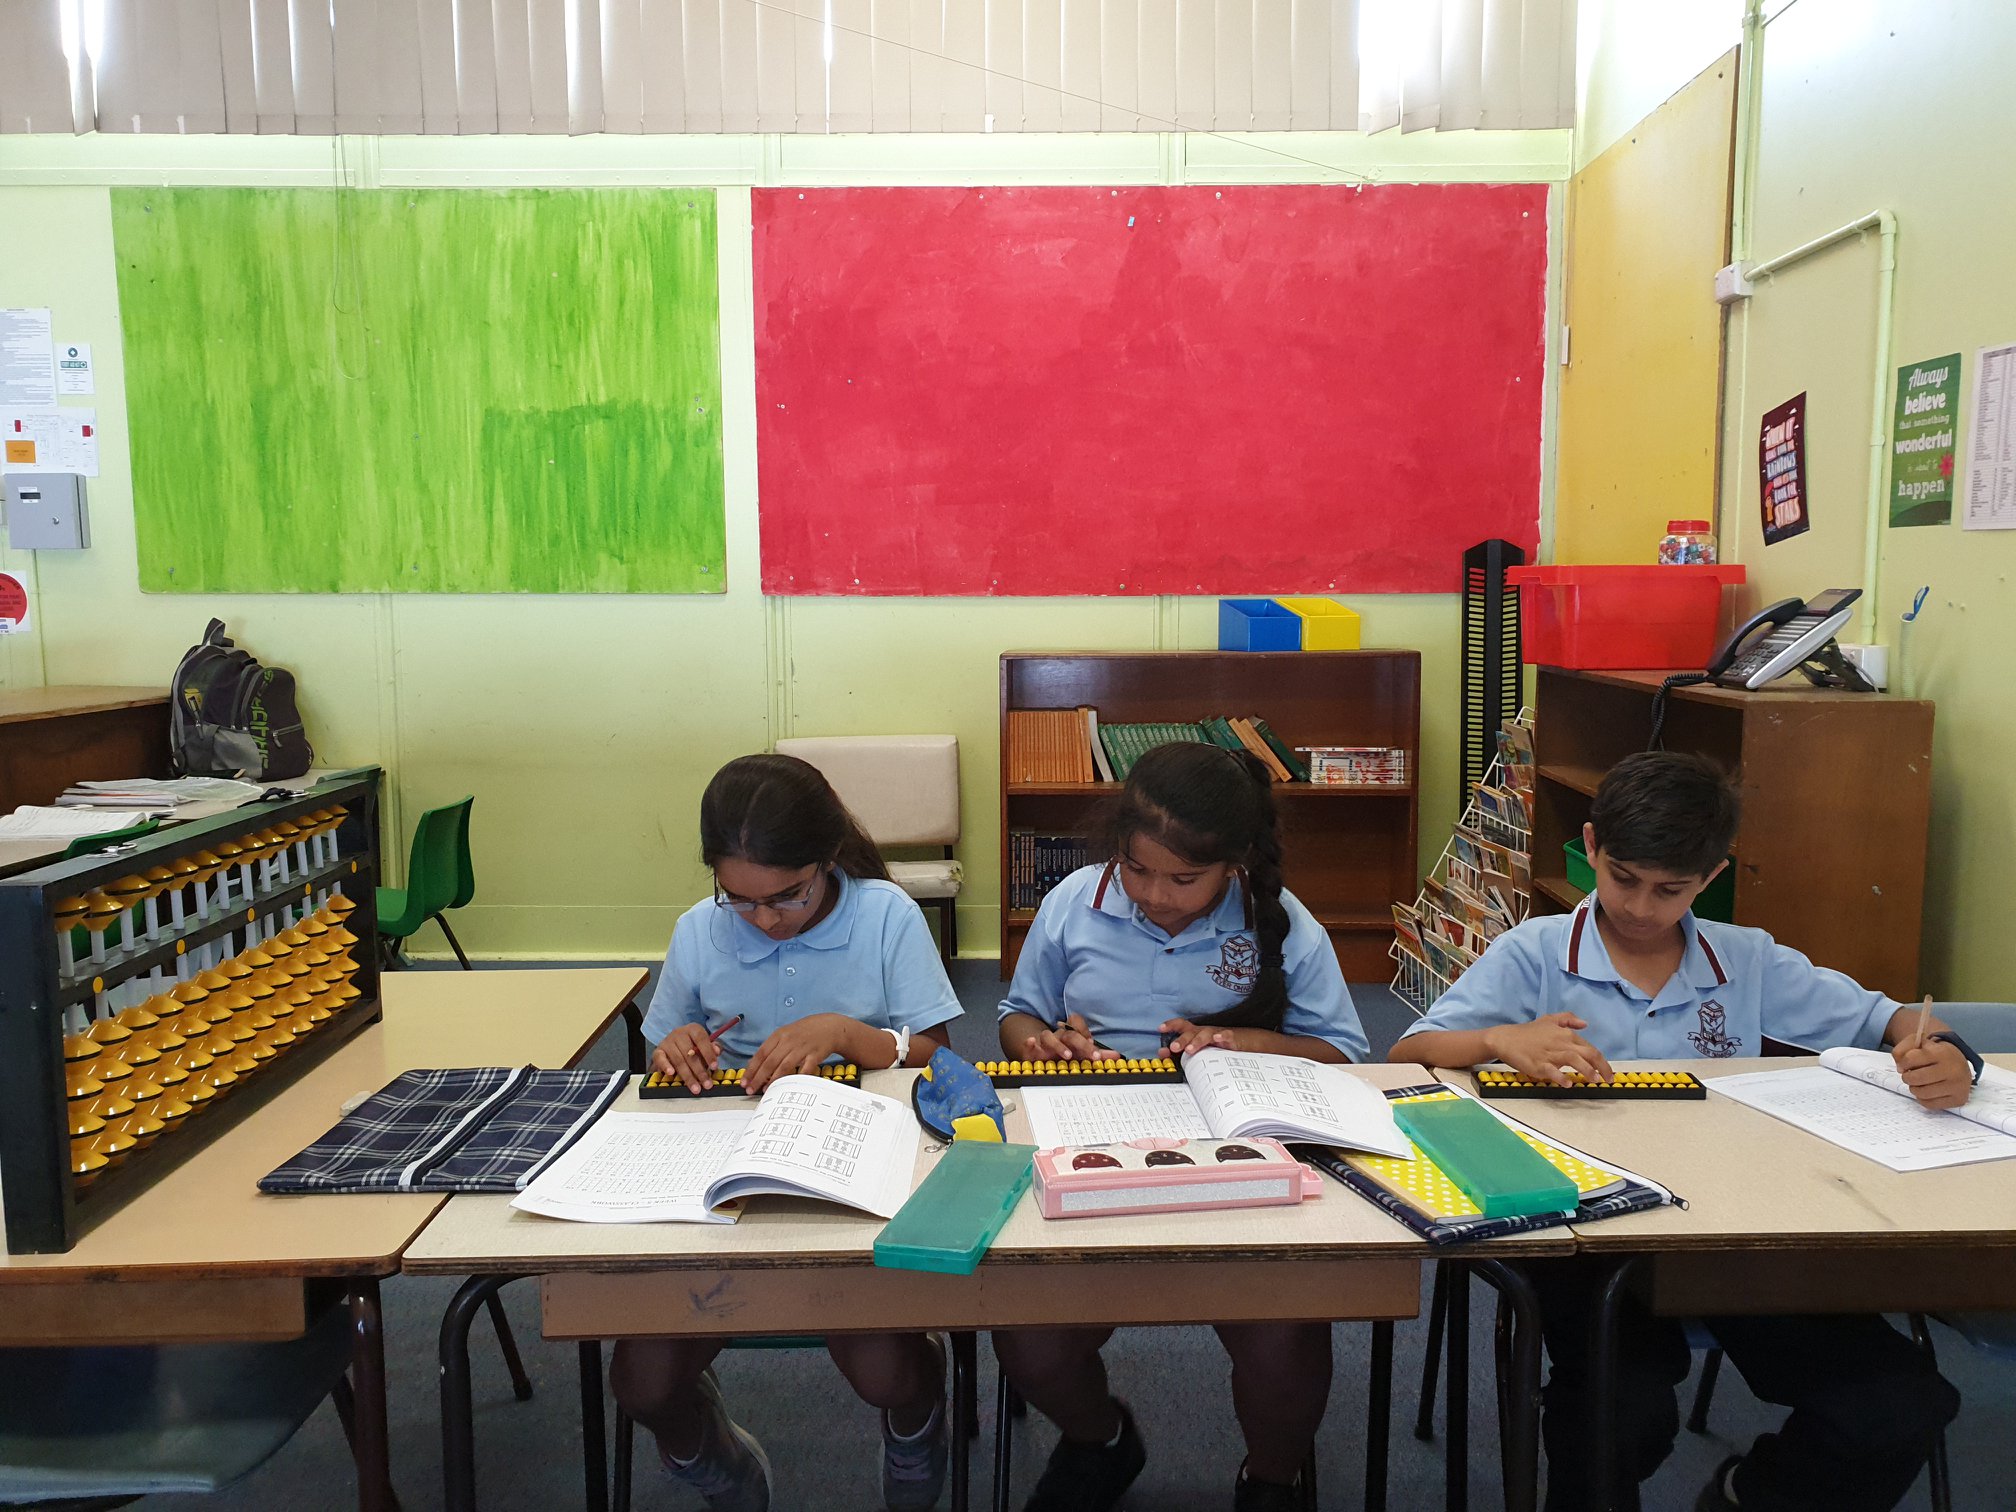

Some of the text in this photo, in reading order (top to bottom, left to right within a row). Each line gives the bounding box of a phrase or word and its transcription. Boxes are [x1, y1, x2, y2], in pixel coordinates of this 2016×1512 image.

[1908, 366, 1949, 391] Always
[1904, 391, 1947, 416] believe
[1895, 428, 1953, 455] wonderful
[1898, 479, 1945, 500] happen
